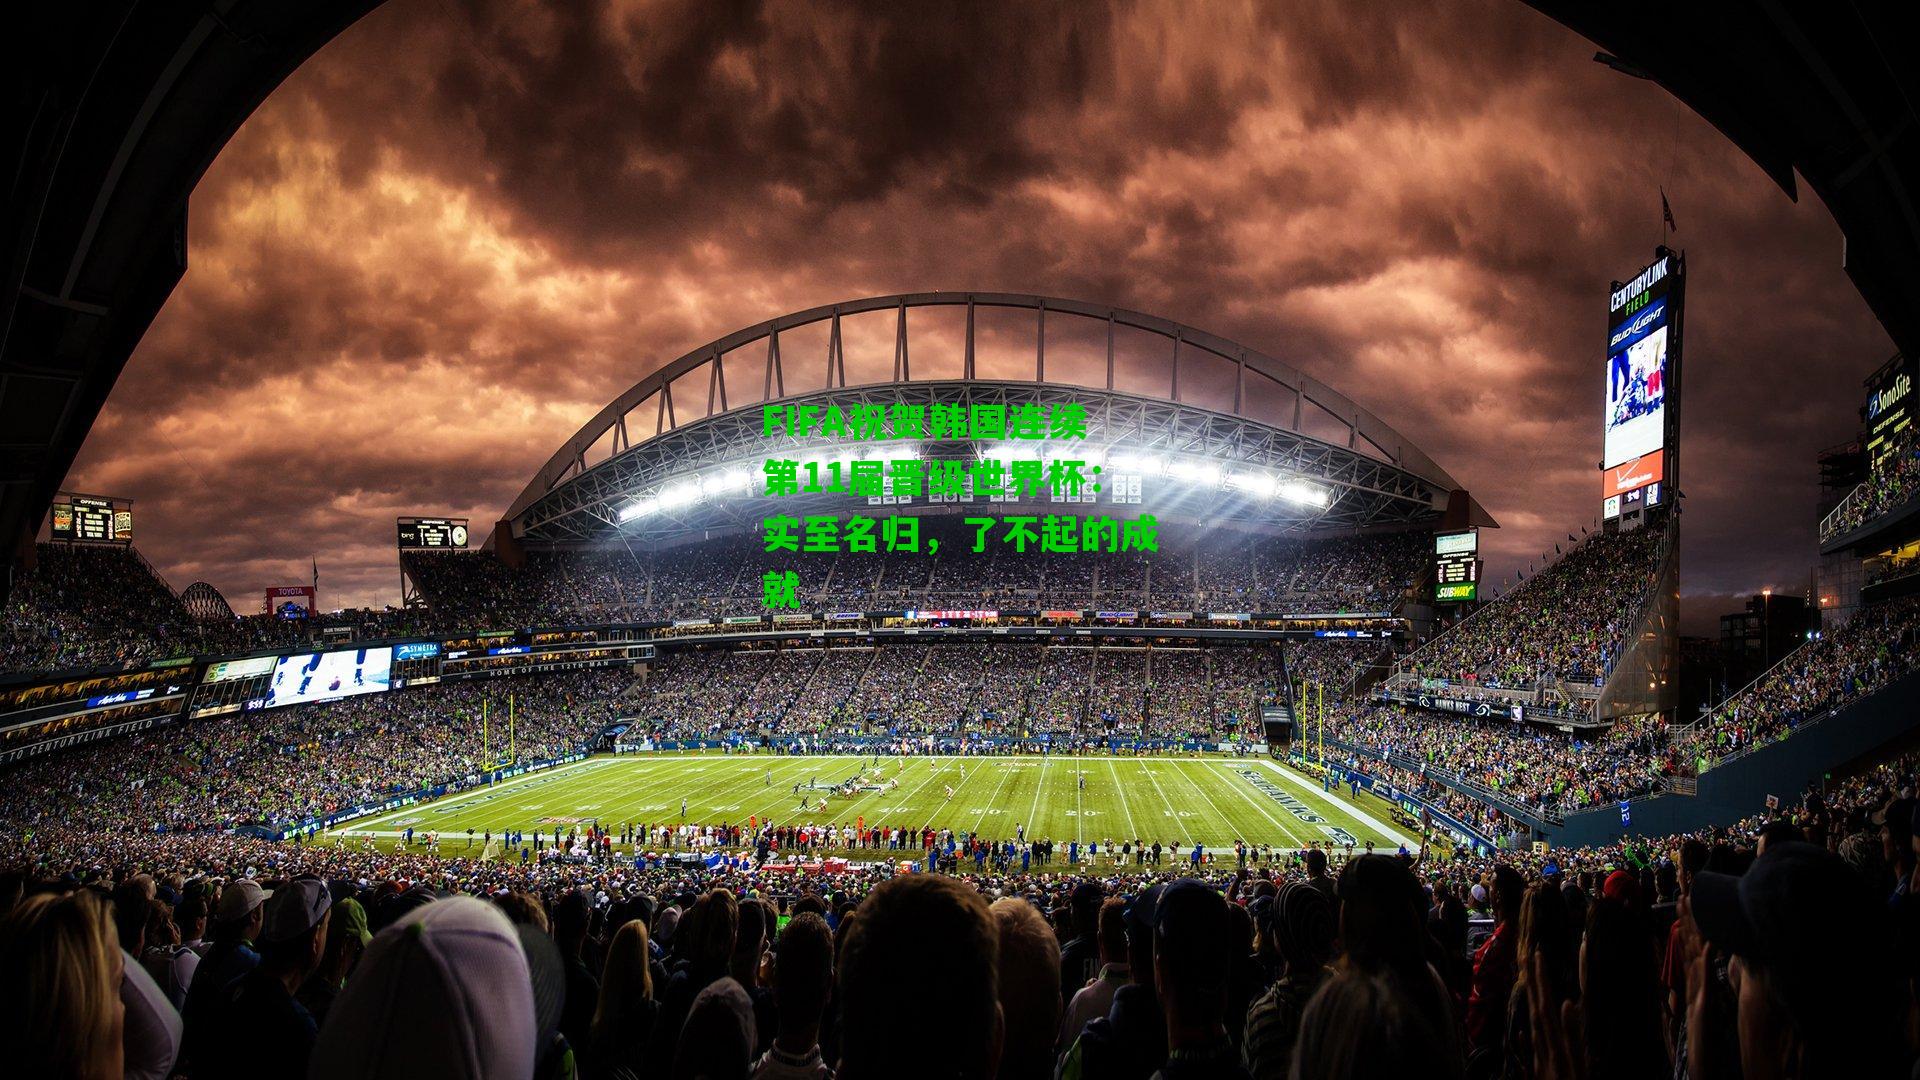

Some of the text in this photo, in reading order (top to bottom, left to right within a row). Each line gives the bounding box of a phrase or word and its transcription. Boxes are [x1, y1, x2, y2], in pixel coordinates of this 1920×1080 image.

[1611, 256, 1668, 313] CENTURYLINK
[1625, 290, 1650, 316] FIELD
[1610, 305, 1665, 347] BUD LIGHT
[1878, 373, 1911, 415] SonoSite
[278, 587, 304, 596] TOYOTA
[1437, 584, 1474, 599] SUBWAY
[409, 644, 438, 653] SYMETRA
[490, 668, 515, 677] HOME
[538, 664, 555, 672] THE
[561, 661, 583, 670] 12TH
[589, 659, 609, 668] MAN
[30, 727, 112, 756] CENTURYLINK
[117, 720, 153, 735] FIELD
[1233, 768, 1330, 824] SEAHAWKS
[1620, 805, 1630, 822] 12
